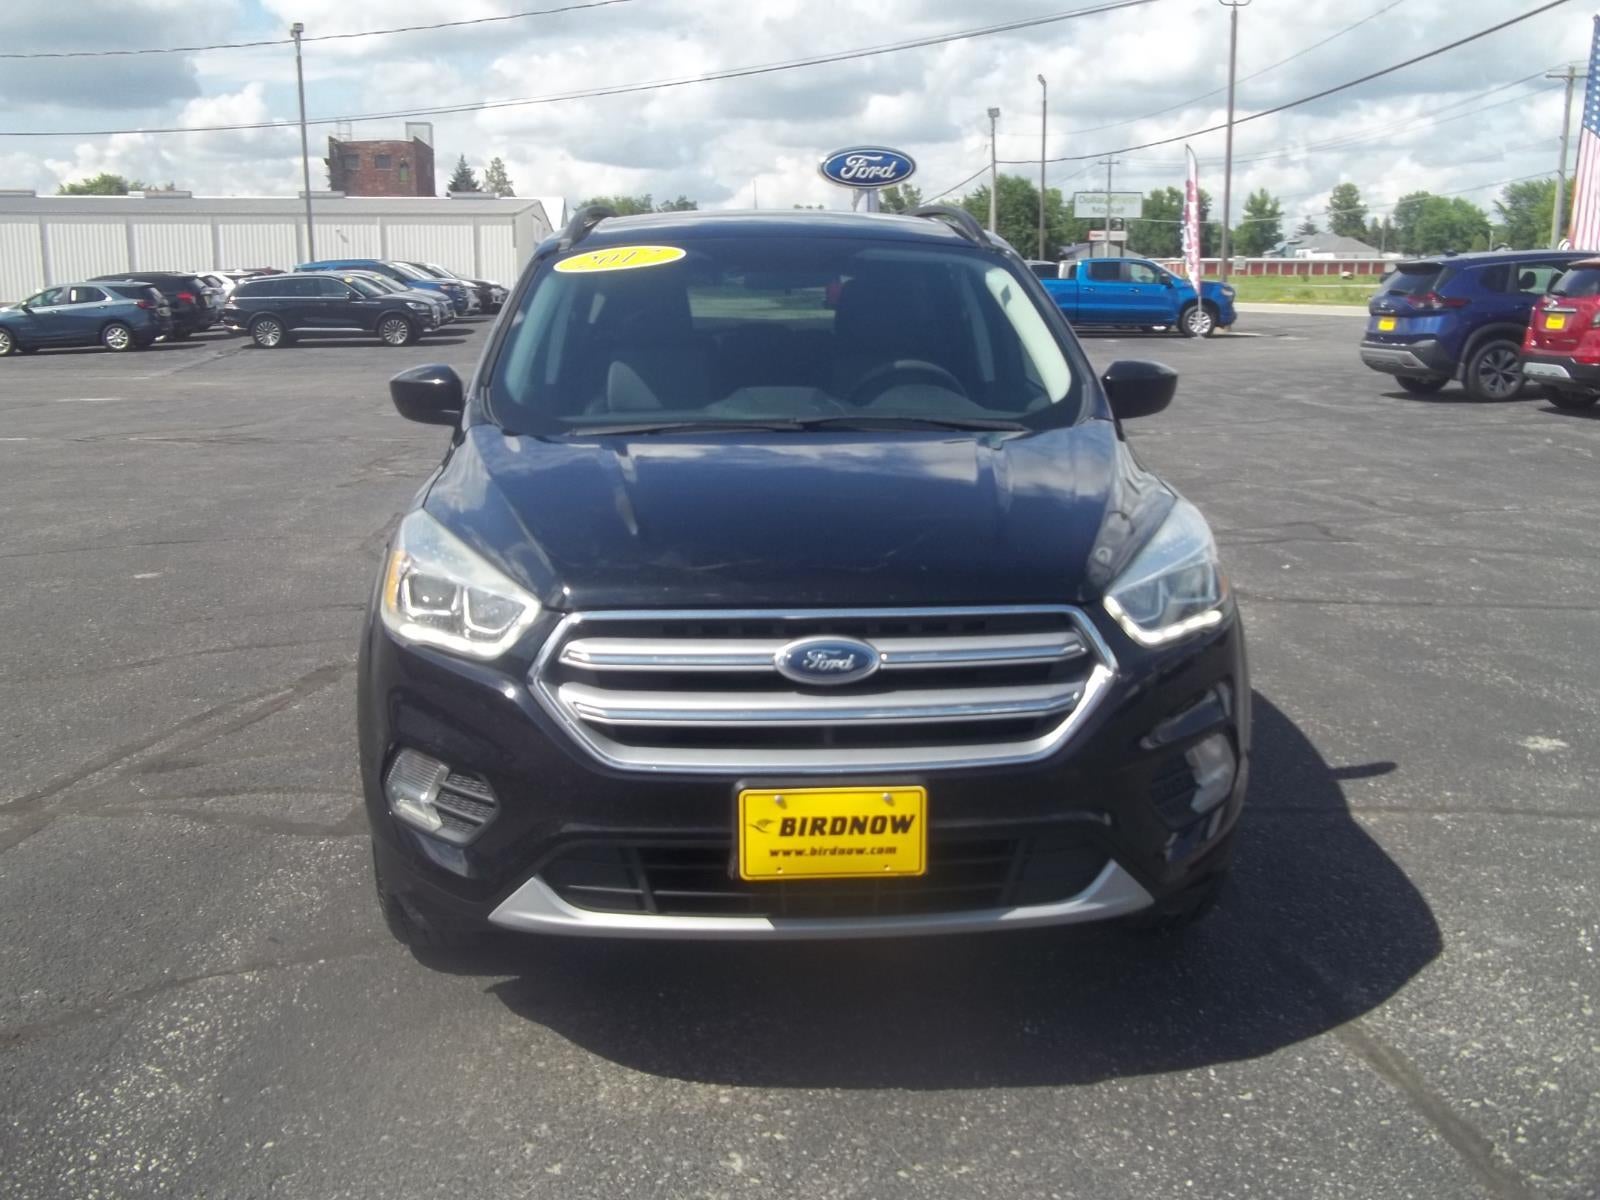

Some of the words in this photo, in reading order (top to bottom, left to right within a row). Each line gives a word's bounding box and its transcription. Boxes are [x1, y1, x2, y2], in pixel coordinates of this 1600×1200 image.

[840, 155, 896, 179] Ford
[1092, 206, 1124, 214] Maket
[803, 649, 855, 671] Ford
[779, 814, 915, 837] BIRDNOW
[769, 845, 897, 858] www.birdnow.com
